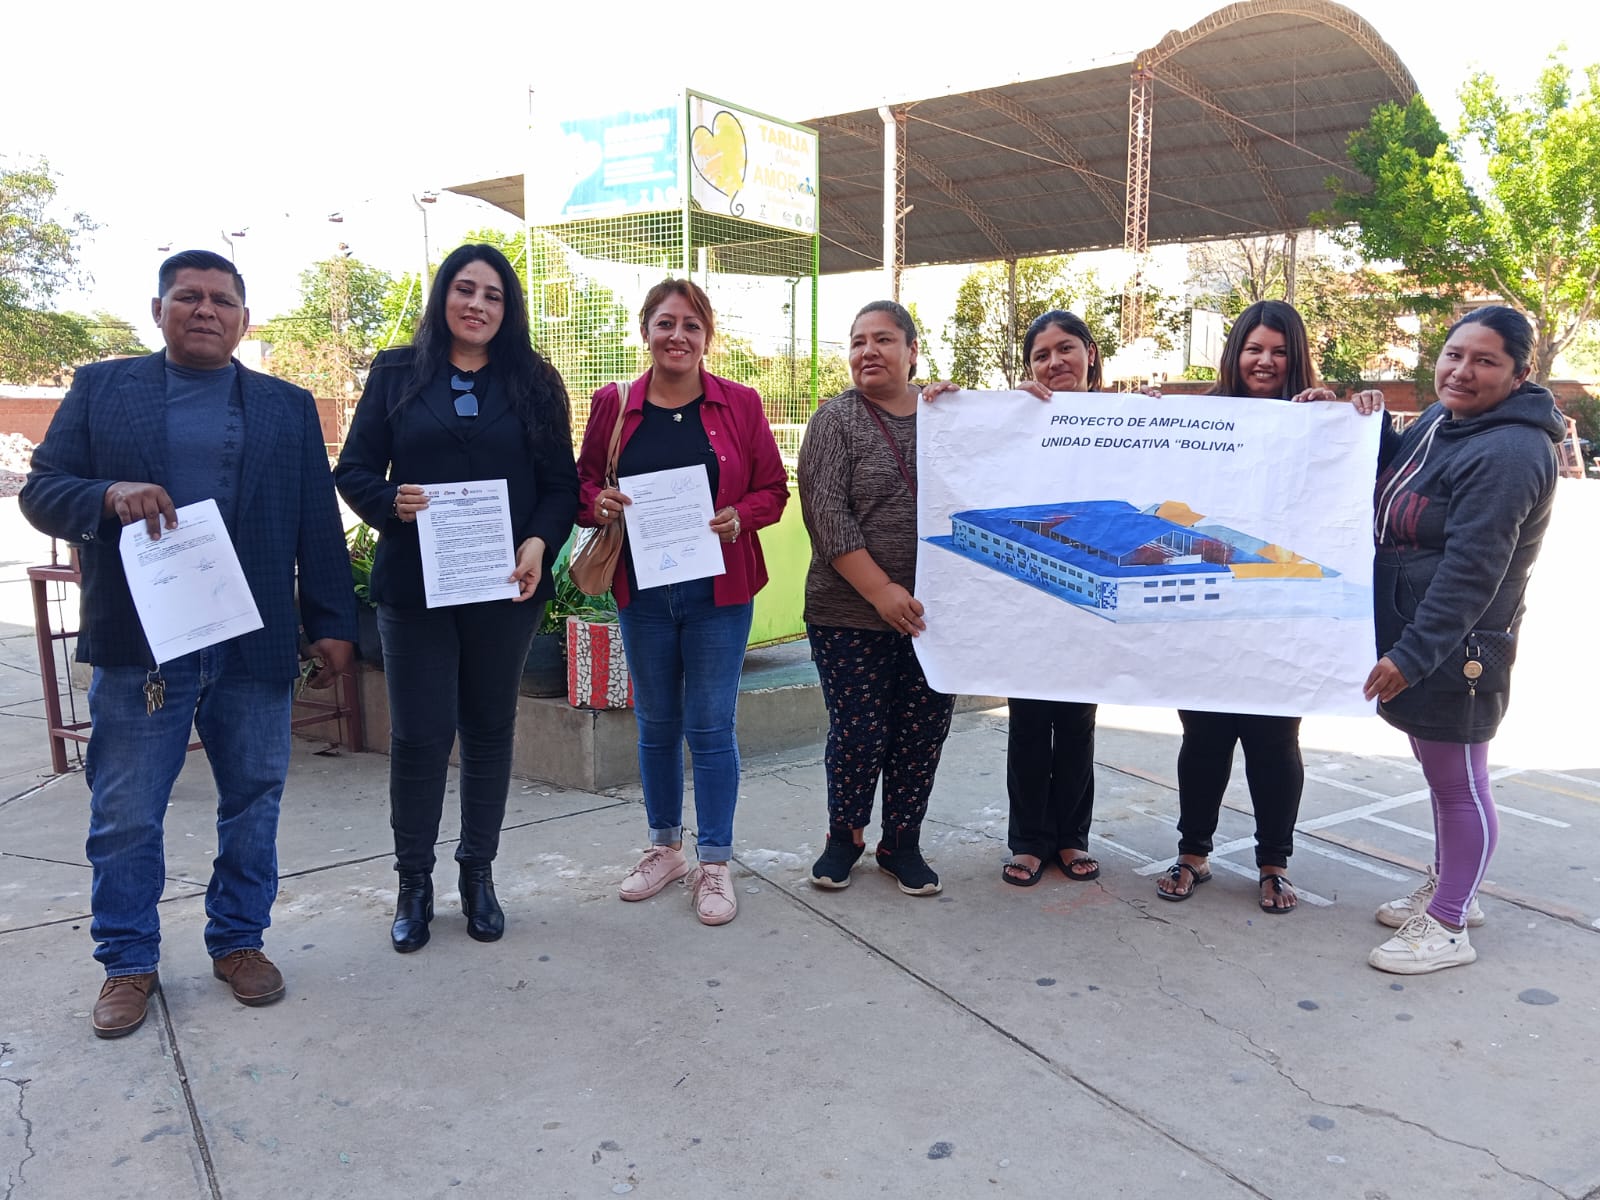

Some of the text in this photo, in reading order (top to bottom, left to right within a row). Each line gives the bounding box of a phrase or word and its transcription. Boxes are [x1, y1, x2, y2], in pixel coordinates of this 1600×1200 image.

[758, 124, 809, 154] TARIJA
[753, 164, 798, 193] AMOR
[1050, 415, 1235, 431] PROYECTO DE AMPLIACIÓN
[1041, 437, 1091, 448] UNIDAD
[1094, 437, 1170, 449] EDUCATIVA
